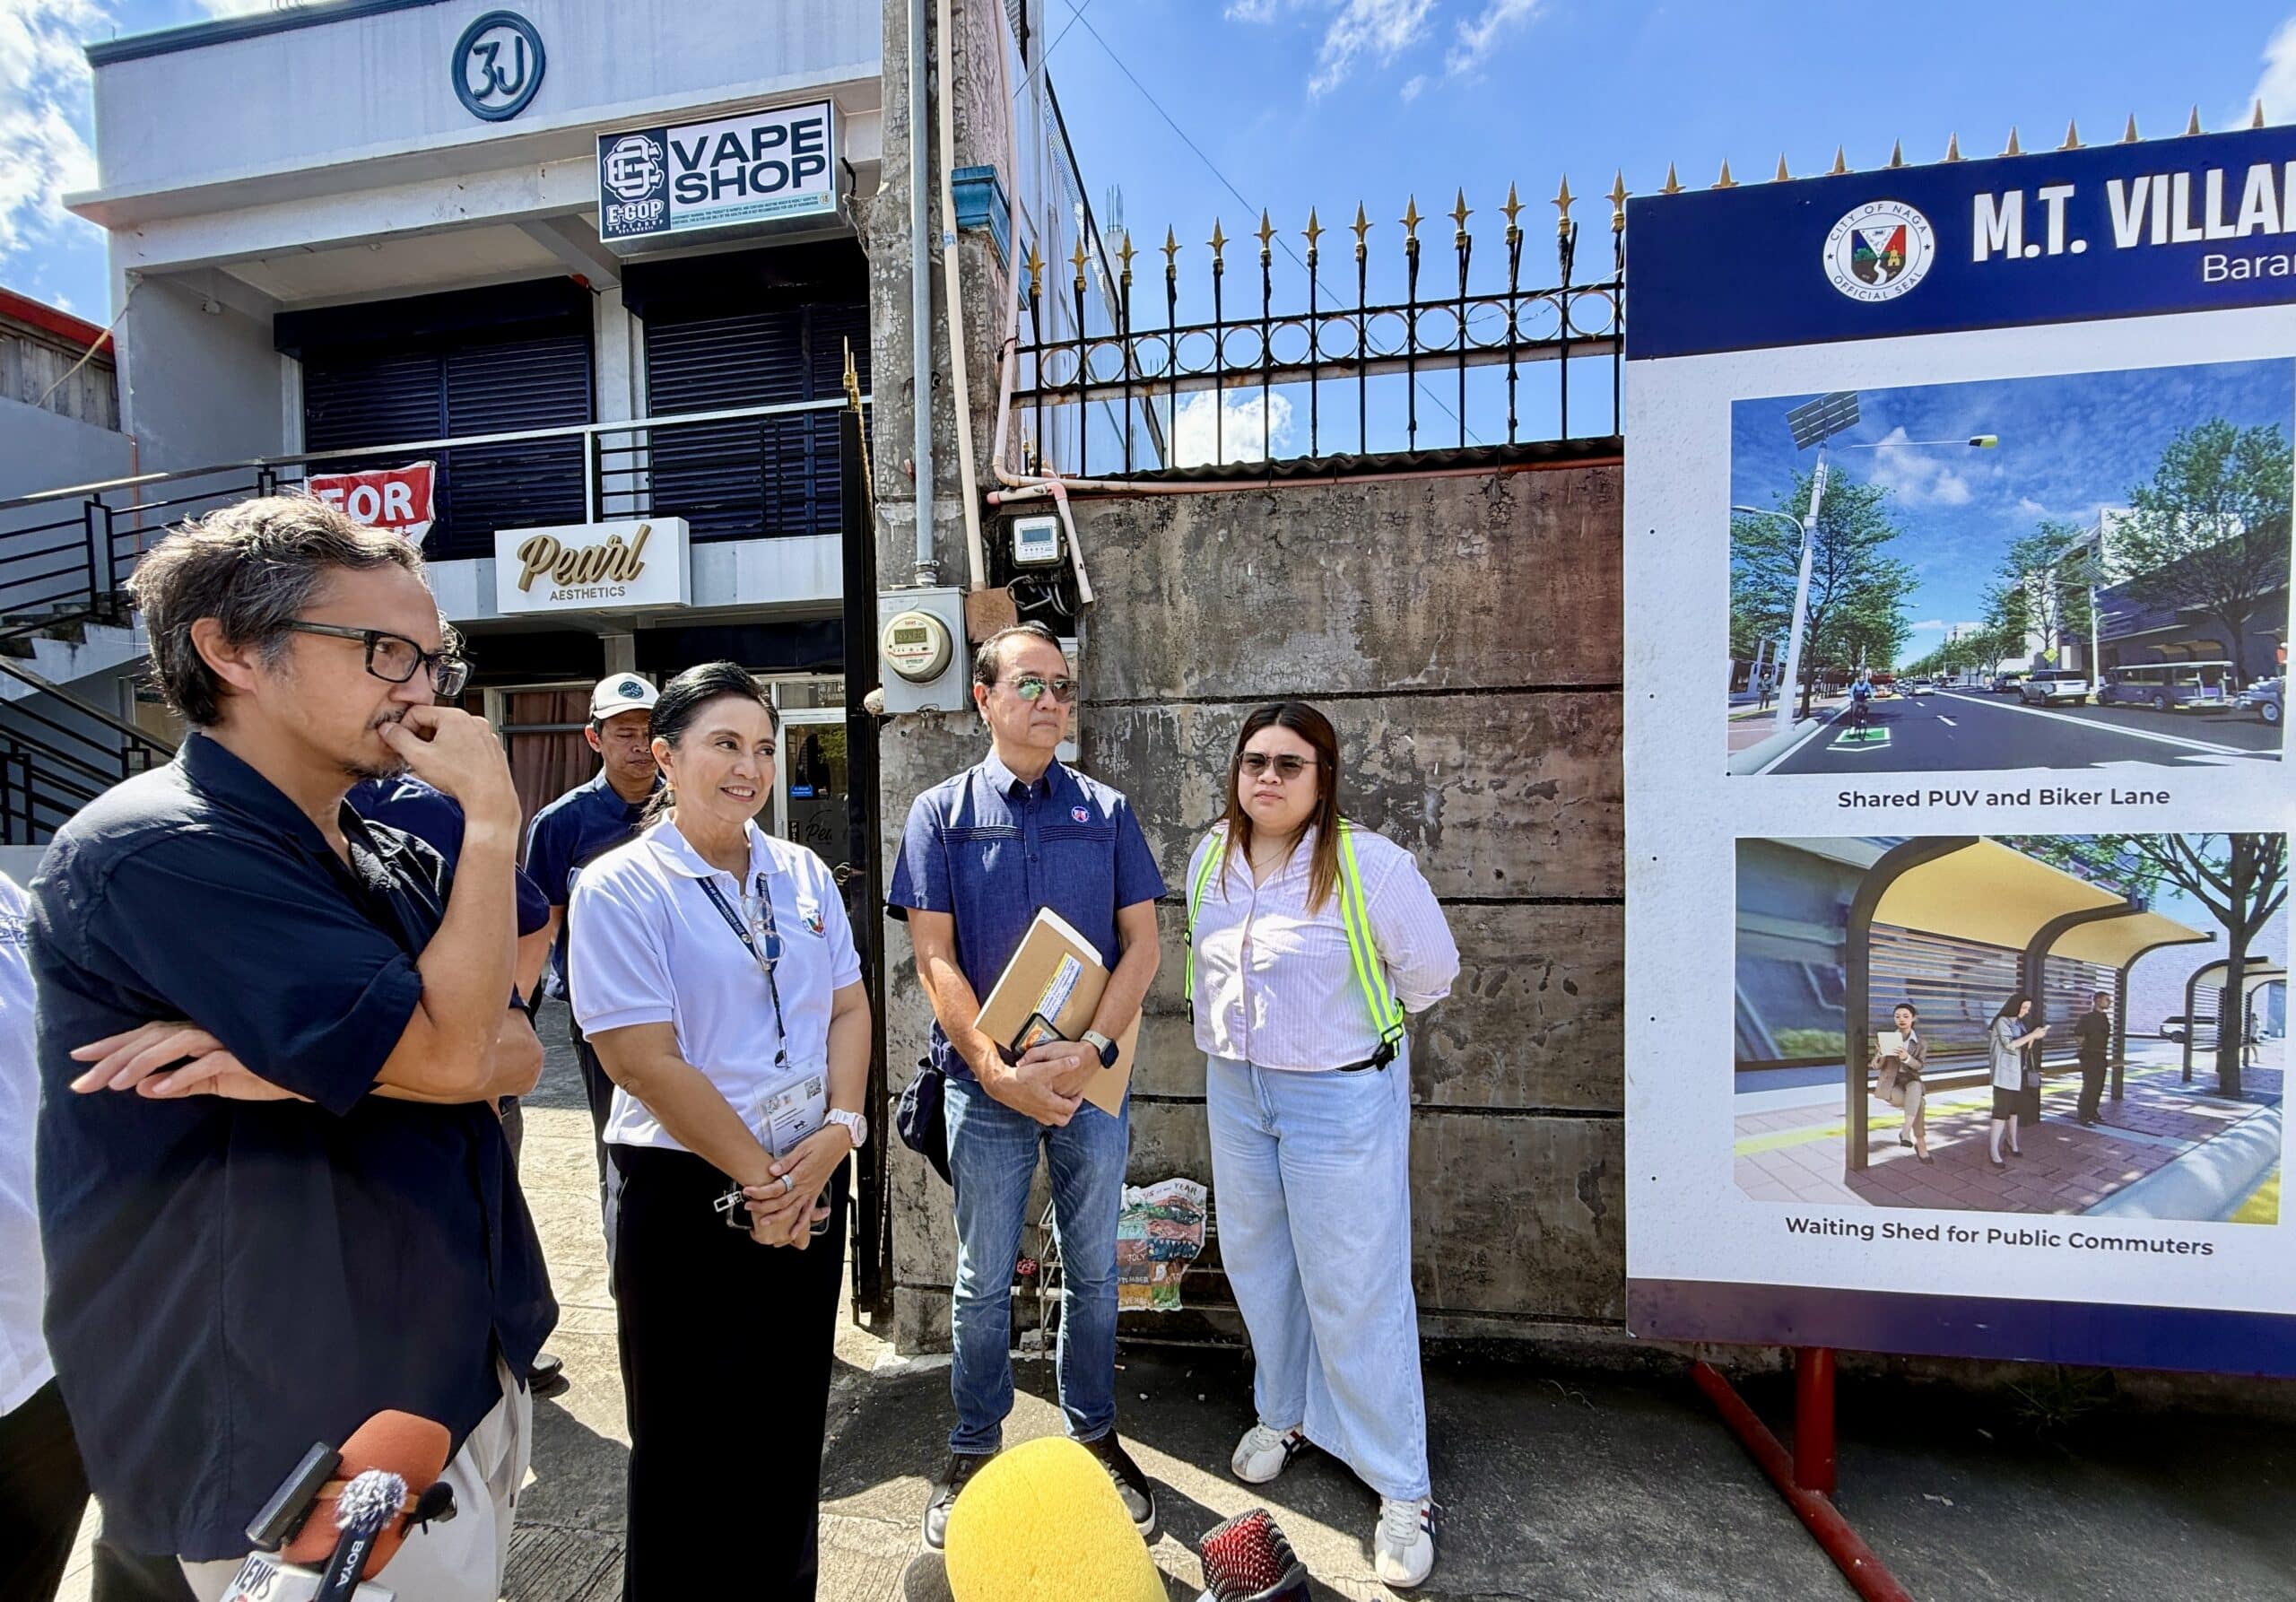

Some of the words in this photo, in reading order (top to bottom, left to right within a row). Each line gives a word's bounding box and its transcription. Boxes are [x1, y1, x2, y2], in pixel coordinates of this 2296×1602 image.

[670, 118, 823, 171] VAPE
[674, 154, 826, 205] SHOP
[608, 200, 663, 224] E-GOP
[1830, 213, 1856, 241] CITY
[1864, 203, 1883, 214] OF
[1892, 204, 1927, 233] NAGA
[1973, 184, 2087, 262] M.T.
[1833, 274, 1888, 300] OFFICIAL
[1894, 273, 1922, 294] SEAL
[2203, 253, 2296, 283] Bara
[517, 524, 651, 592] Pearl
[549, 586, 626, 602] AESTHETICS
[1838, 790, 1920, 808] Shared
[1928, 789, 1979, 806] PUV
[1986, 788, 2030, 806] and
[2039, 787, 2102, 805] Biker
[2110, 788, 2170, 805] Lane
[1785, 1216, 1875, 1241] Waiting
[1882, 1223, 1939, 1242] Shed
[1947, 1225, 1979, 1243] for
[1987, 1228, 2061, 1248] Public
[2068, 1232, 2213, 1256] Commuters
[335, 1540, 364, 1588] BOYA
